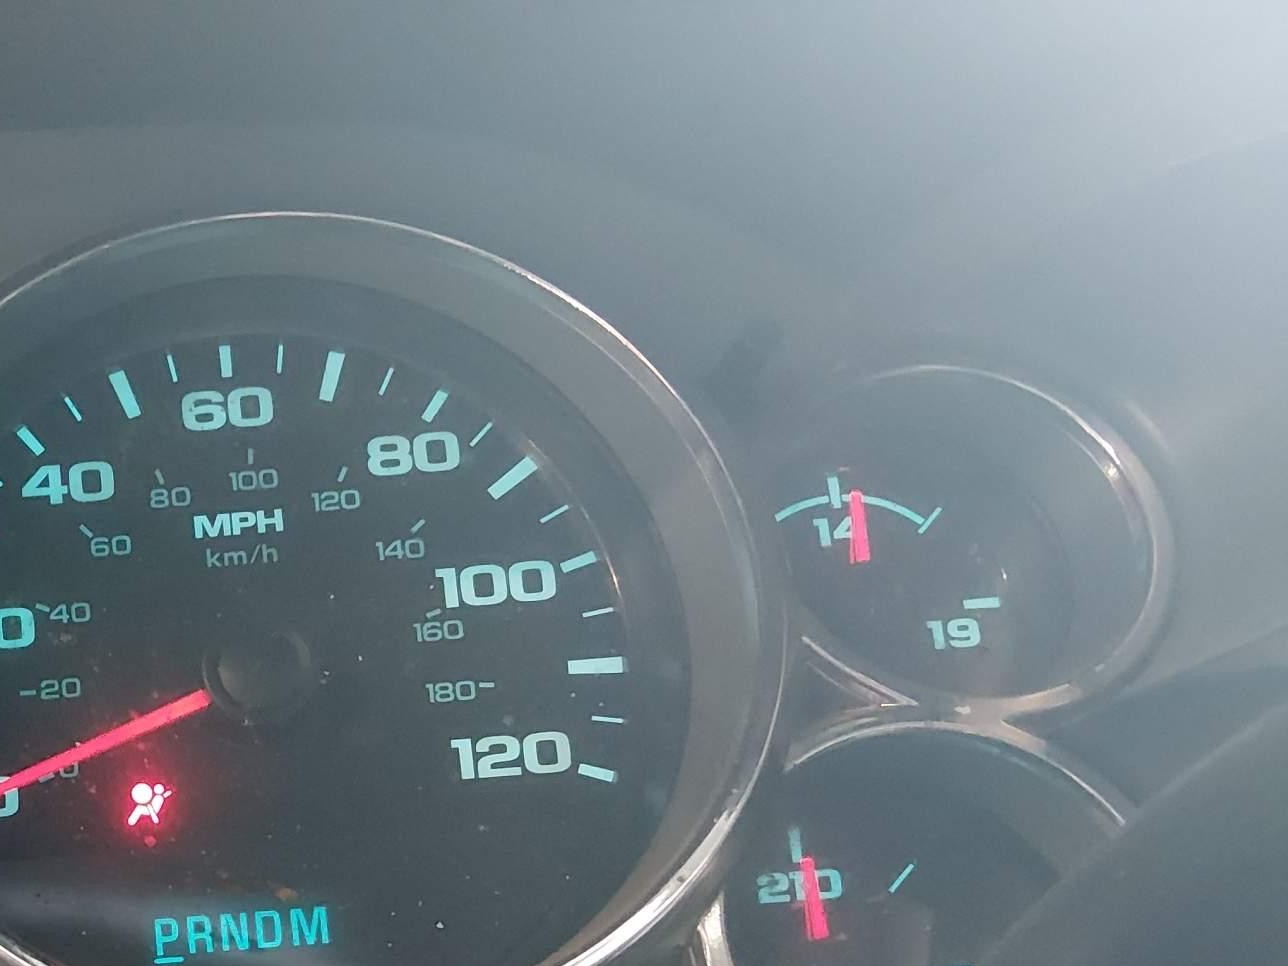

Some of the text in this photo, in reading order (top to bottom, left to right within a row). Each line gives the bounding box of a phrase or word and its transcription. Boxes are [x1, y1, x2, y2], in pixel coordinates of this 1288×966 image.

[181, 386, 274, 432] 60
[367, 431, 460, 476] 80
[22, 461, 114, 505] 40
[228, 468, 279, 492] 100
[150, 487, 191, 508] 80
[311, 489, 361, 512] 120
[193, 509, 285, 540] MPH
[90, 535, 132, 557] 60
[205, 543, 279, 568] km/h
[375, 539, 425, 561] 140
[435, 560, 557, 609] 100
[49, 602, 91, 624] 40
[413, 620, 464, 642] 160
[926, 618, 981, 650] 19
[40, 677, 81, 699] 20
[425, 680, 476, 703] 180
[450, 731, 572, 780] 120
[756, 868, 843, 904] 210
[154, 907, 330, 957] PRNDM
